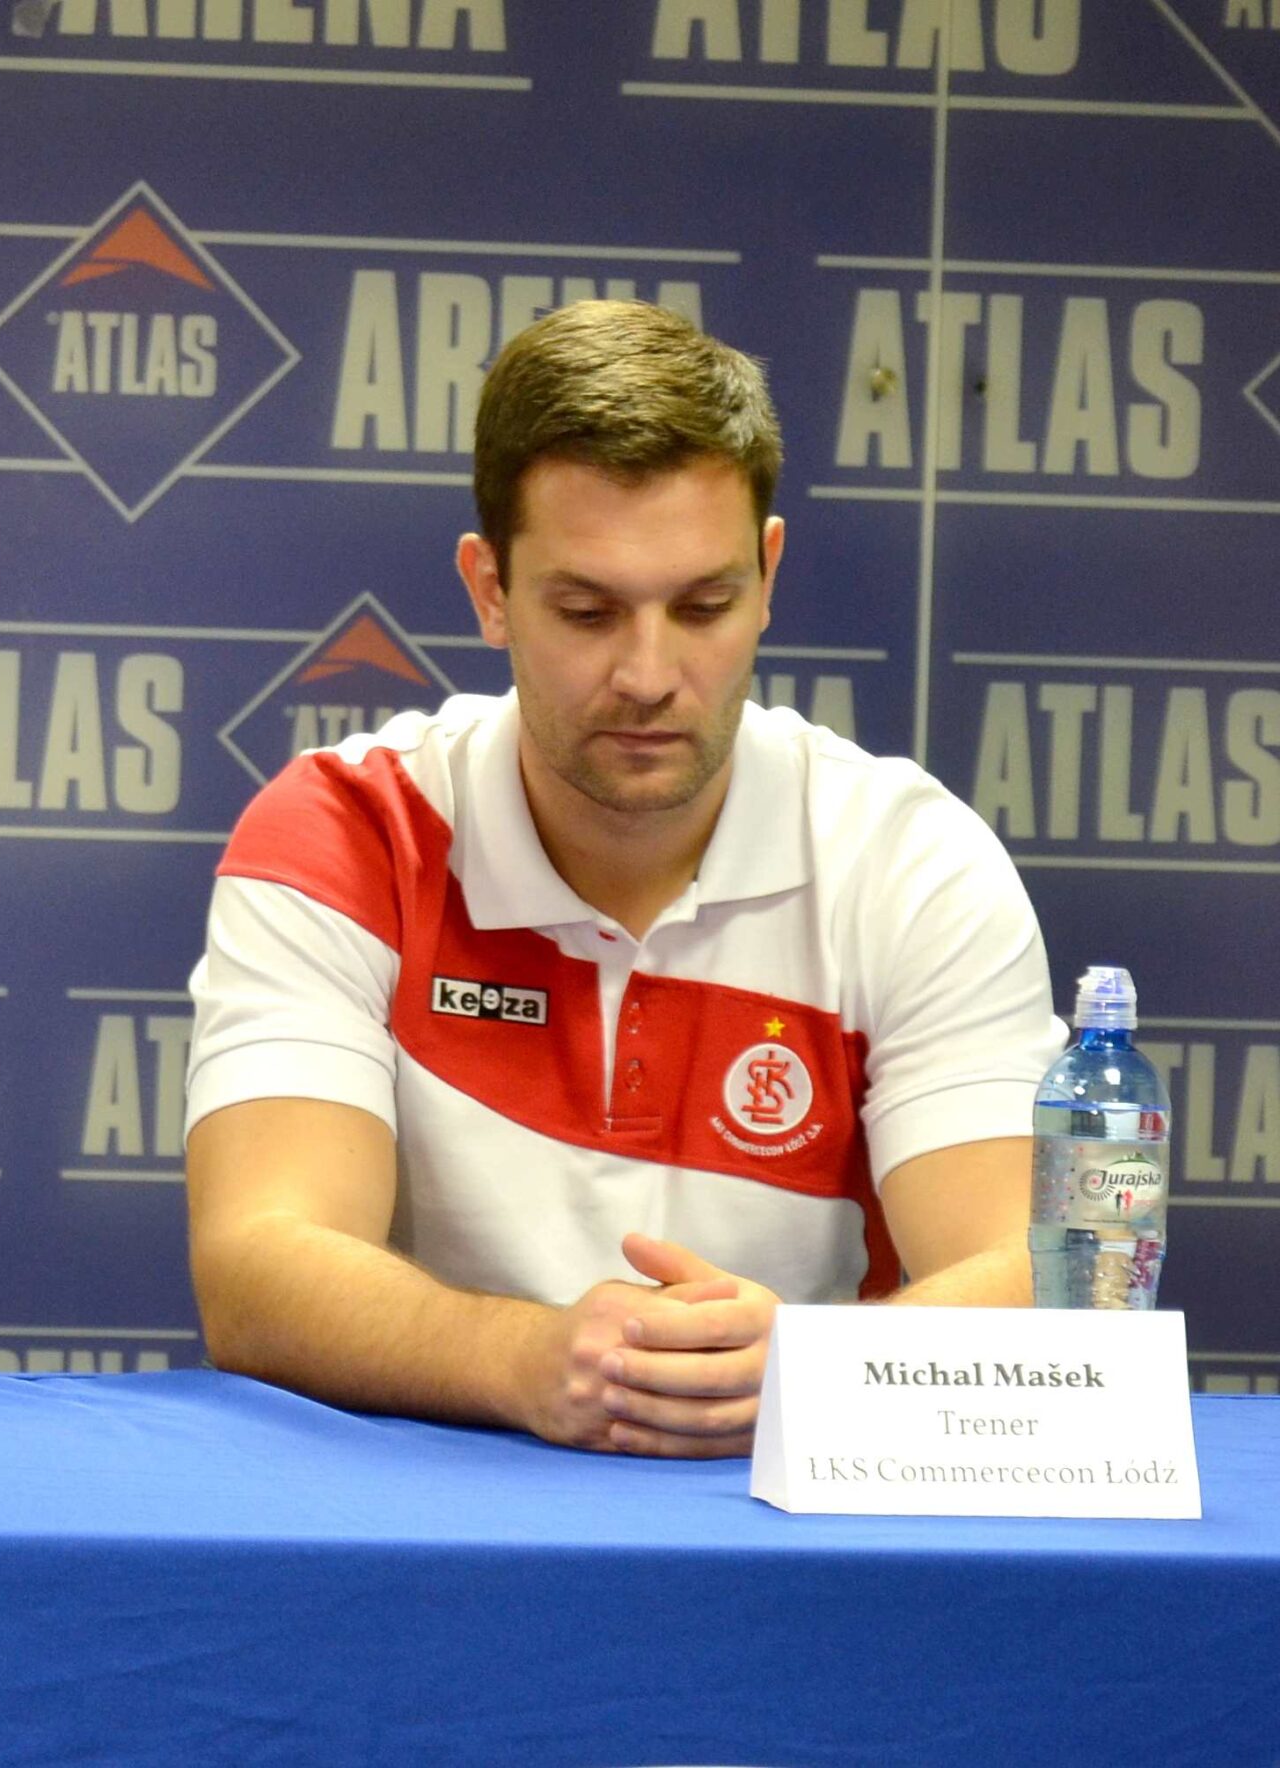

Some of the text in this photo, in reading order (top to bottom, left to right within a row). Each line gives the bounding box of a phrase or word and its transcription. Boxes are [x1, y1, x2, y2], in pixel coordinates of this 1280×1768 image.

[53, 311, 218, 398] ATLAS
[836, 289, 1204, 478] ATLAS
[971, 682, 1280, 846] ATLAS
[438, 981, 542, 1020] keeza
[1100, 1170, 1161, 1190] Jurajska
[864, 1361, 1106, 1389] Michal Mašek
[938, 1410, 1039, 1436] Trener
[809, 1457, 869, 1482] ŁKS
[877, 1458, 1095, 1485] Commercecon
